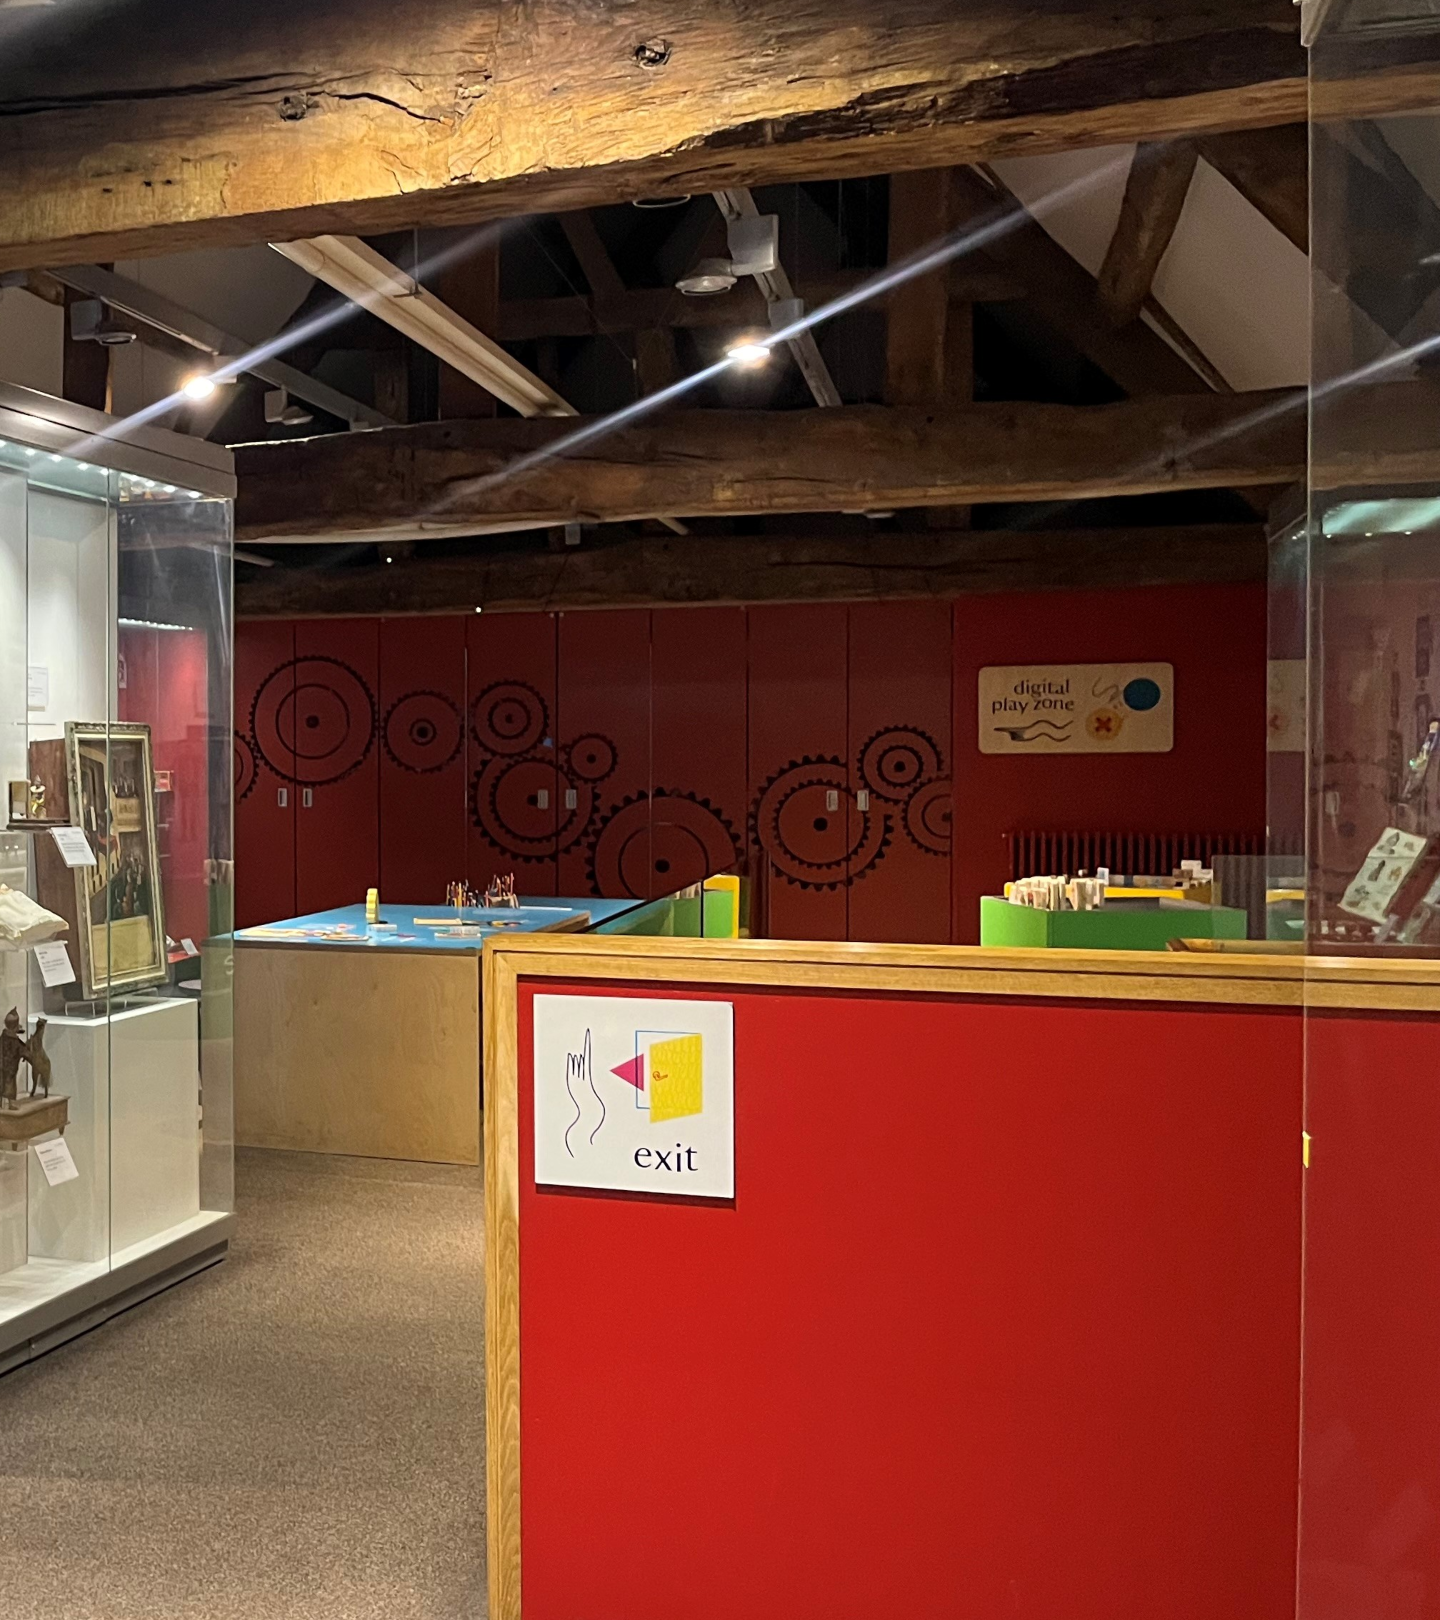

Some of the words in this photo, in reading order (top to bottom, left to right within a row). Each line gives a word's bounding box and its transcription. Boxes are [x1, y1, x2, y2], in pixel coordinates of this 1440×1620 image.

[1013, 679, 1070, 698] digital
[992, 698, 1029, 715] play
[1033, 699, 1075, 712] zone
[633, 1142, 698, 1173] exit
